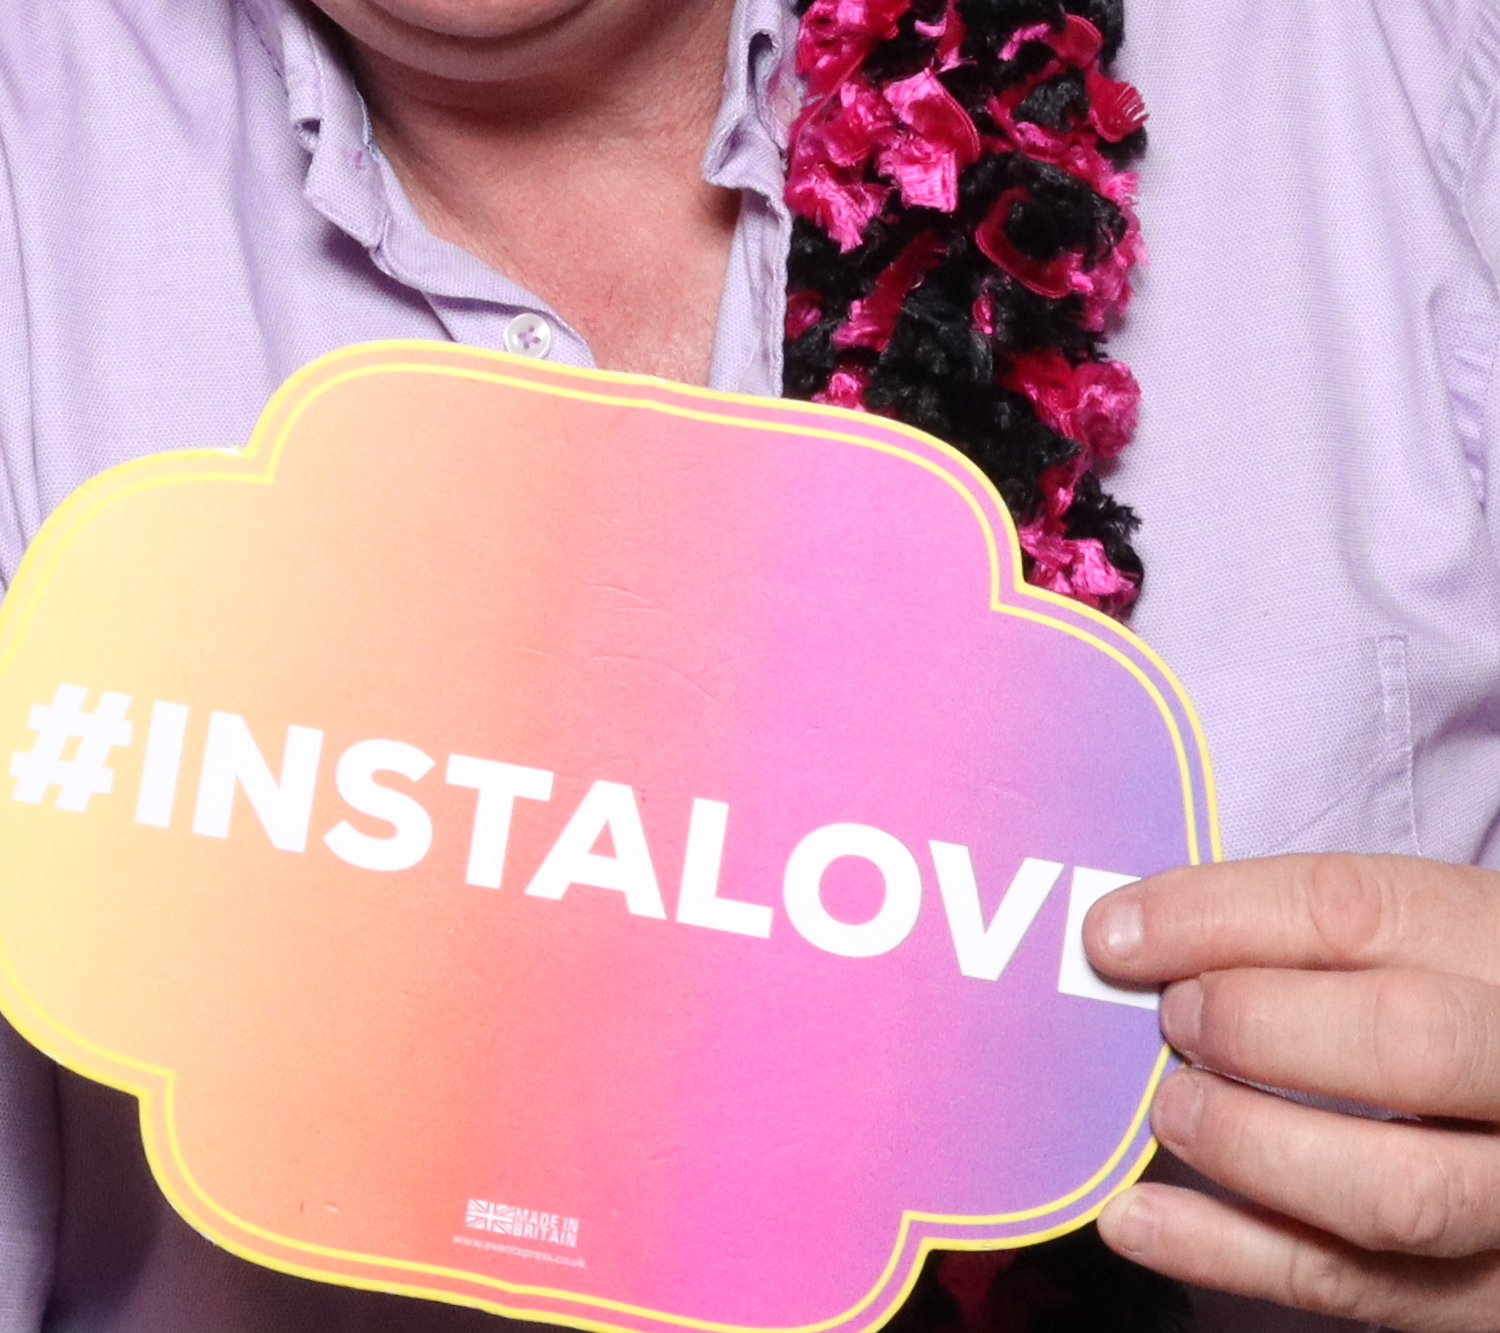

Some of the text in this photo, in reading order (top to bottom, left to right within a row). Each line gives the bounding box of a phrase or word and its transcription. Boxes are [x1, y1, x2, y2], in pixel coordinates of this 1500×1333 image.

[514, 1207, 579, 1233] MADE IN
[512, 1222, 578, 1248] BRITAIN
